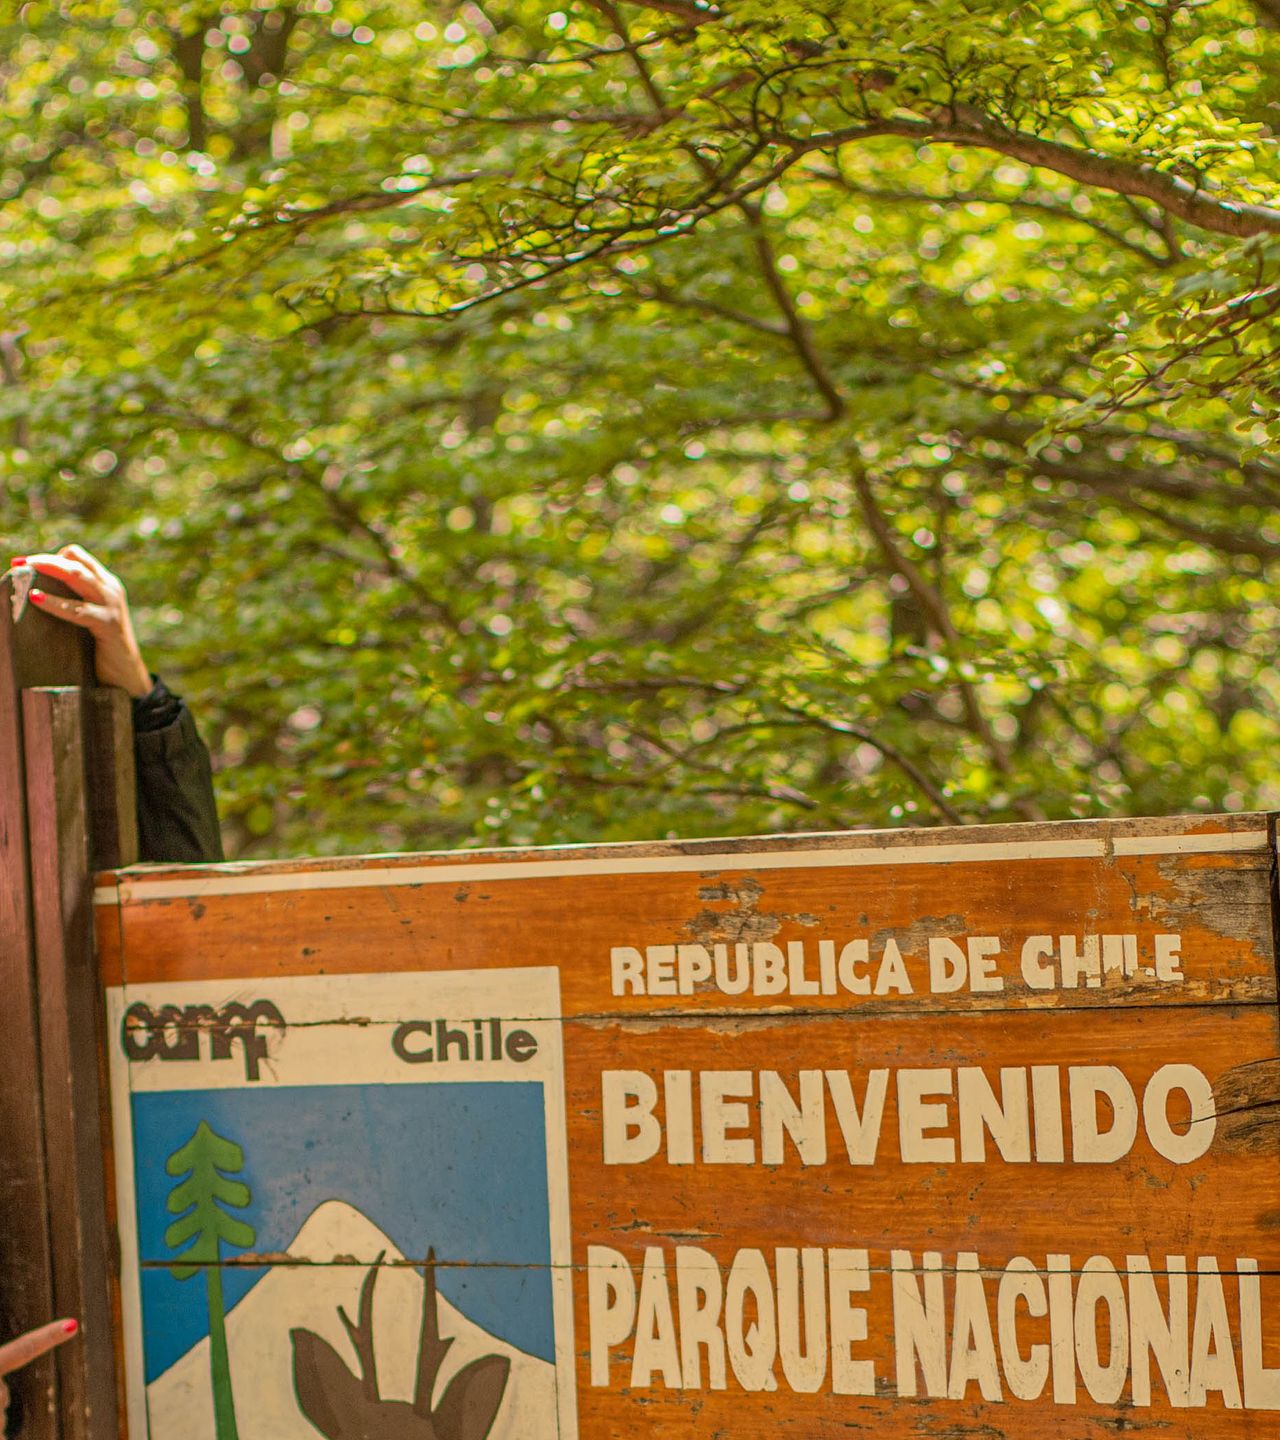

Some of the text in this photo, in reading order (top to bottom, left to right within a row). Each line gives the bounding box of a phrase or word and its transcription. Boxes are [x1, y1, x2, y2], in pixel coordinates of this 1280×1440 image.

[610, 934, 1184, 996] REPUBLICA DE CHILE
[392, 1018, 538, 1064] Chile
[601, 1064, 1216, 1165] BIENVENIDO
[587, 1246, 876, 1396] PARQUE
